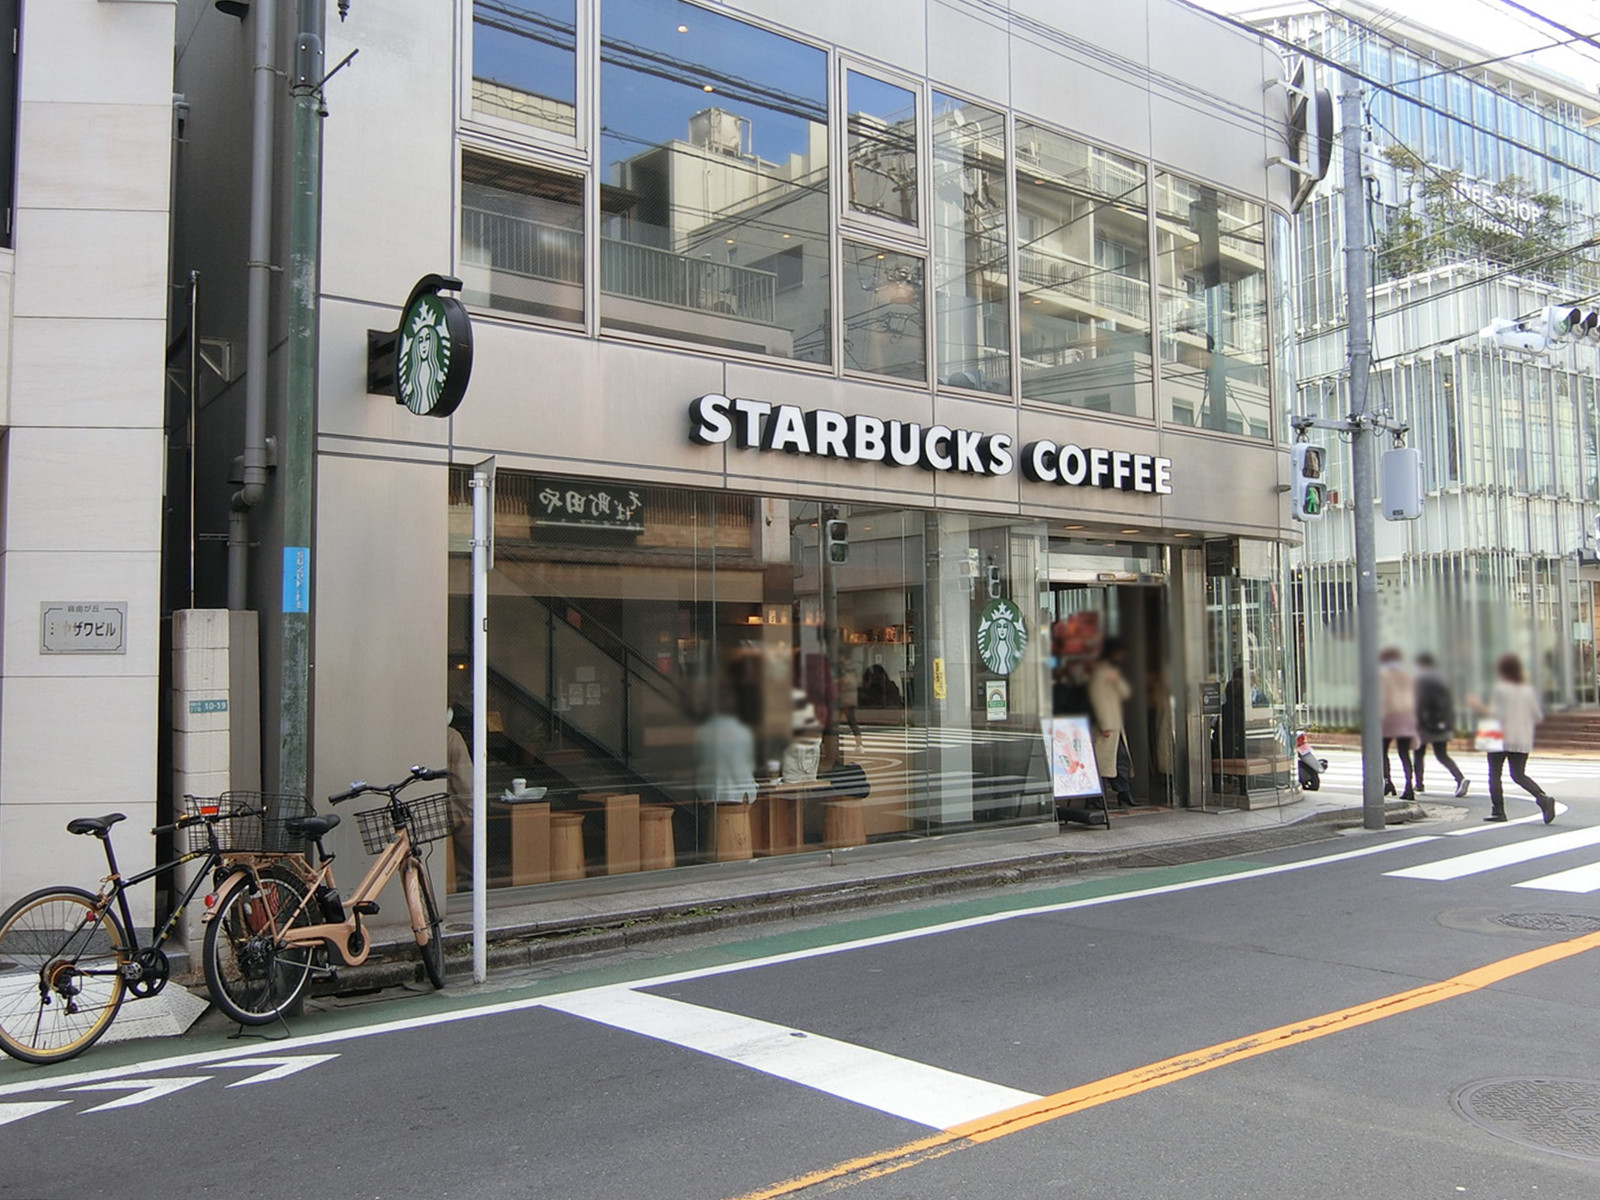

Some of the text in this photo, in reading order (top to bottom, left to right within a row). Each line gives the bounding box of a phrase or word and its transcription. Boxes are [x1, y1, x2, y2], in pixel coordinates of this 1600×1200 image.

[1495, 195, 1541, 223] SHOP
[694, 394, 1173, 495] STARBUCKS COFFEE
[204, 702, 226, 710] 10-19
